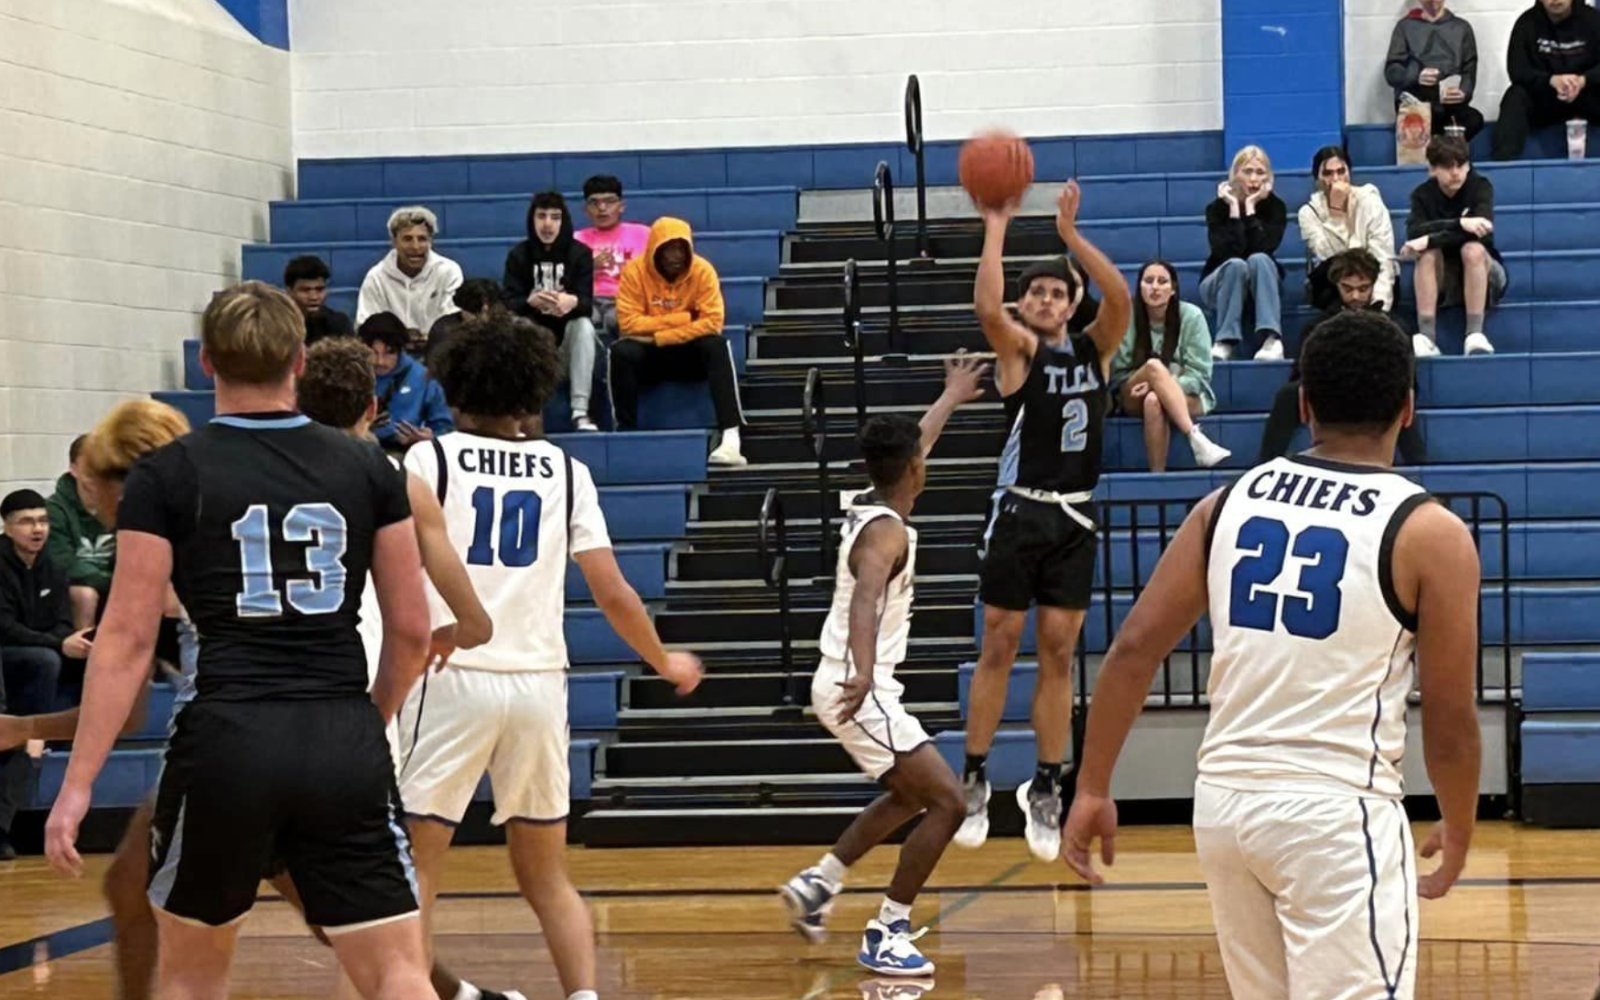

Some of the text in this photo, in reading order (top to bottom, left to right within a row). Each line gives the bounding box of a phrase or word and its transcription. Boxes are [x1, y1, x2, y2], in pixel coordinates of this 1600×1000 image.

[1061, 398, 1088, 452] 2
[458, 447, 554, 479] CHIEFS
[1247, 470, 1381, 517] CHIEFS
[231, 502, 348, 617] 13
[466, 485, 543, 568] 10
[1229, 515, 1350, 641] 23
